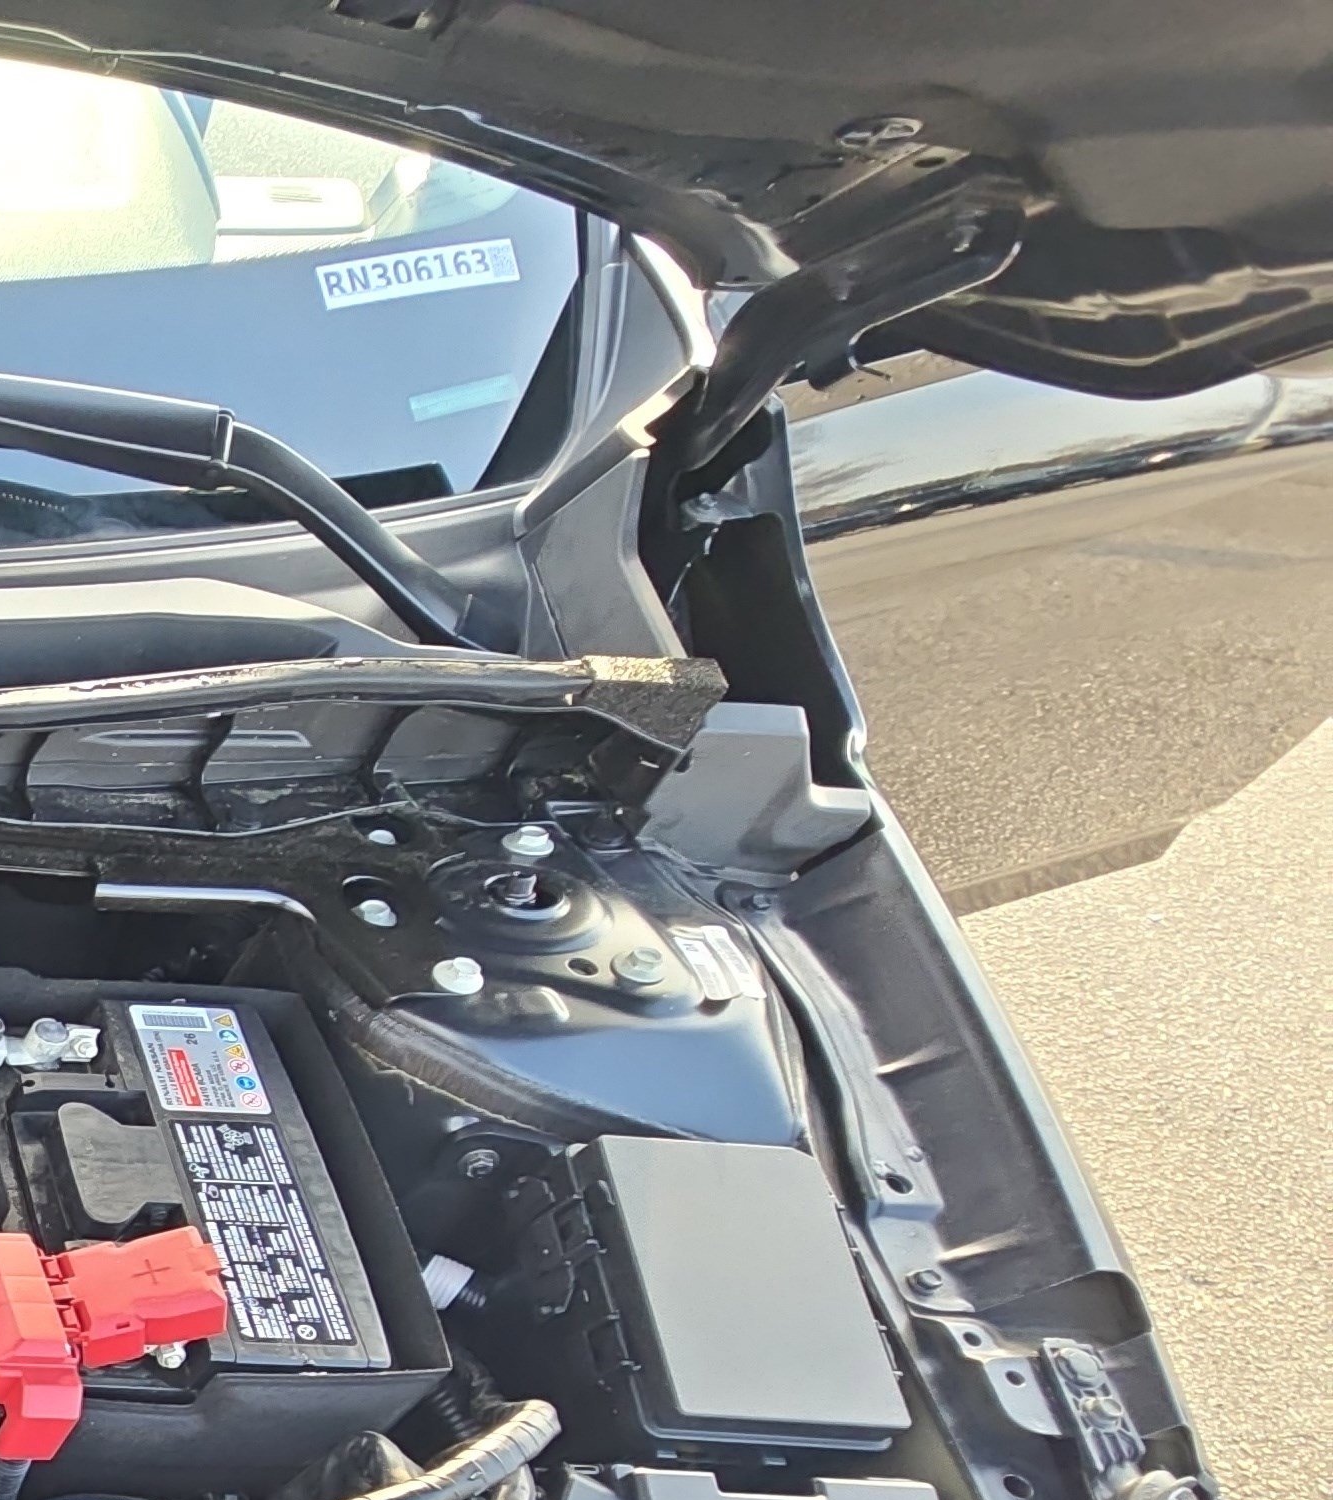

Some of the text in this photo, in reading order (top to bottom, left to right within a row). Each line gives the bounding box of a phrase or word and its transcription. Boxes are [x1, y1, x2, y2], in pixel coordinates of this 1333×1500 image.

[323, 247, 490, 297] RN306163
[184, 1033, 198, 1045] 26
[147, 1042, 173, 1106] RENAULT NISSAN
[199, 1086, 213, 1106] 24410
